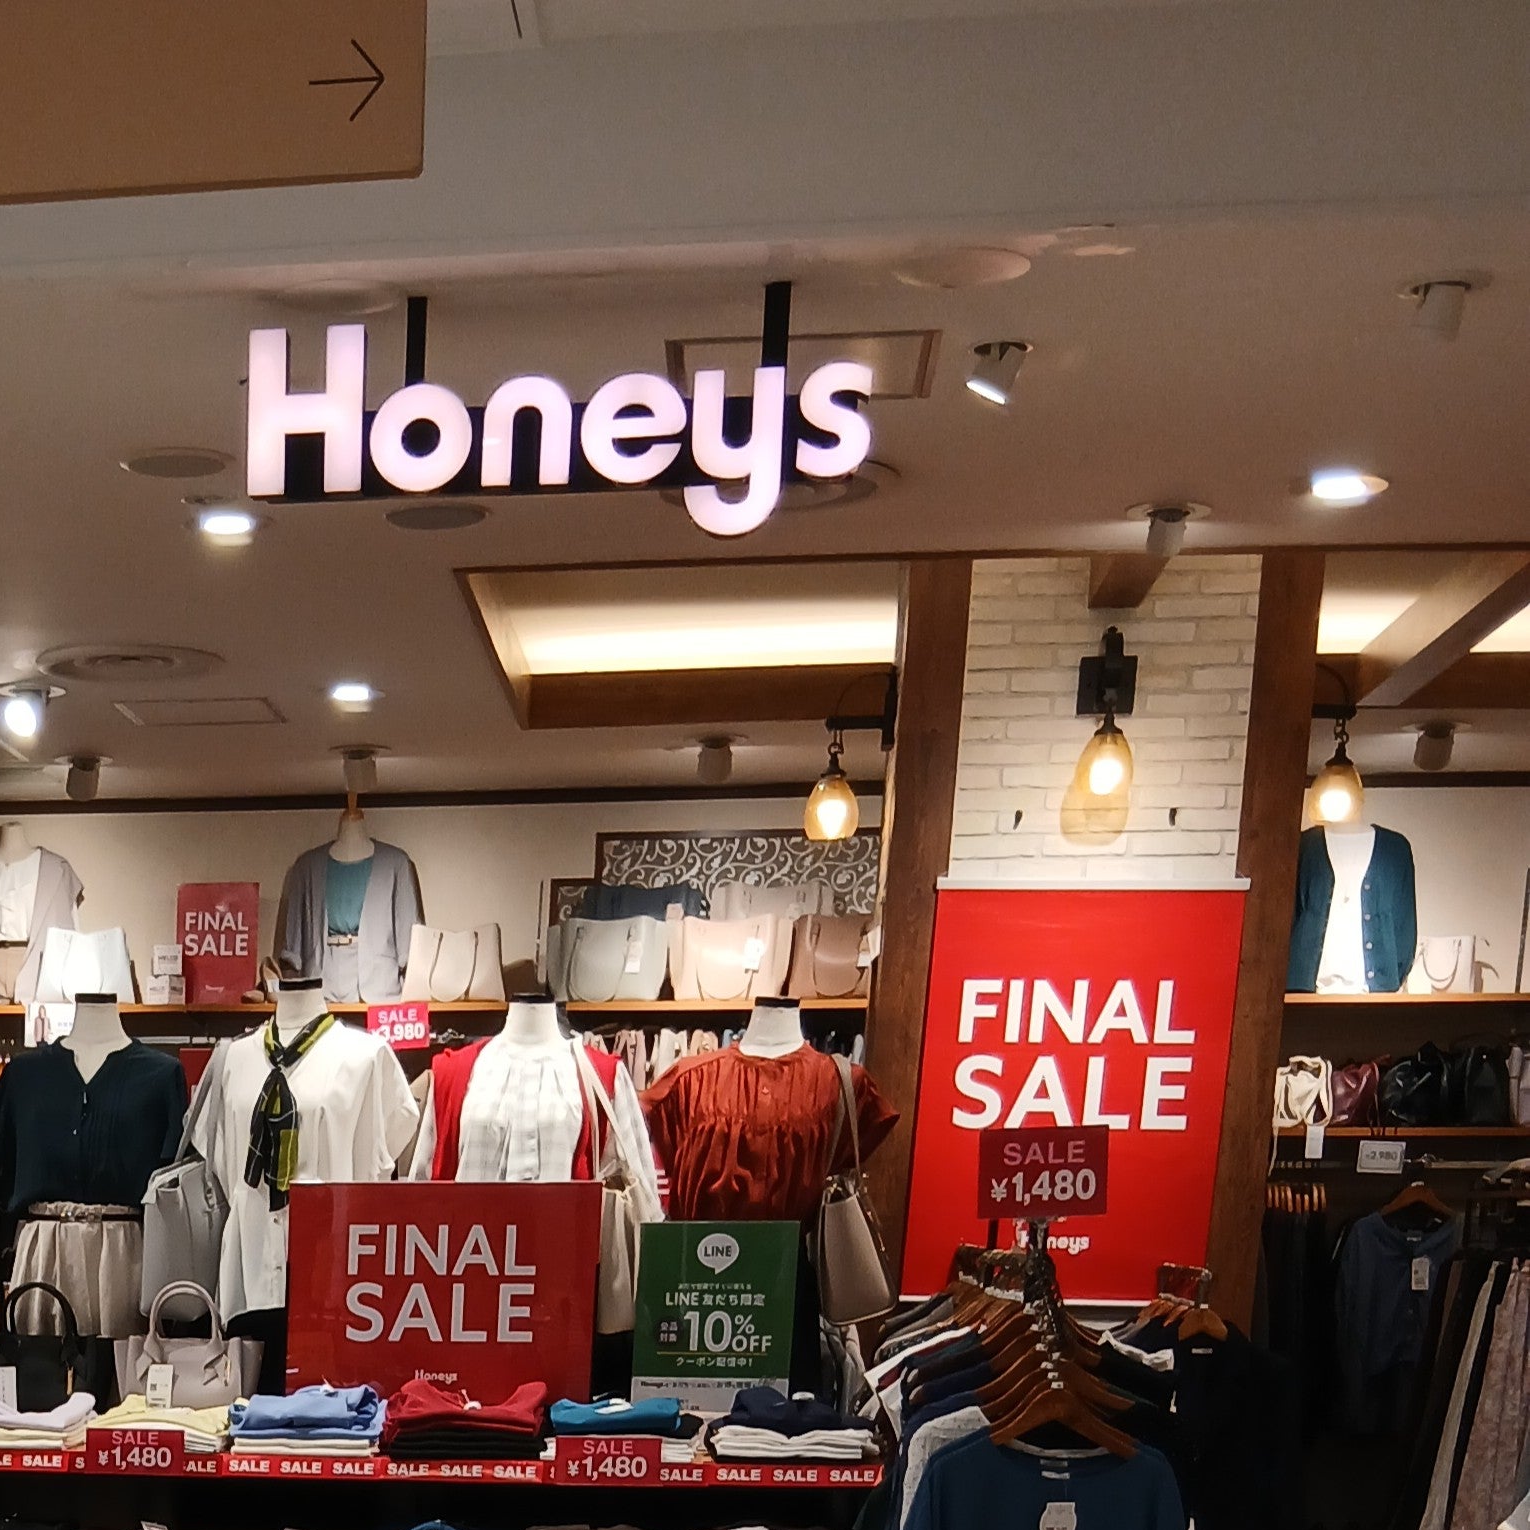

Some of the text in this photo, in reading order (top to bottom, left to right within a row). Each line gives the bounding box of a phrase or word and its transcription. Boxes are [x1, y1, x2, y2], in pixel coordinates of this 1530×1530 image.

[246, 323, 874, 537] Honeys
[185, 911, 249, 931] FINAL
[184, 933, 249, 956] SALE
[378, 1008, 418, 1024] SALE
[957, 979, 1196, 1044] FINAL
[952, 1054, 1193, 1131] SALE
[1003, 1140, 1086, 1166] SALE
[991, 1169, 1097, 1206] ¥1,480
[347, 1224, 537, 1276] FINAL
[703, 1246, 732, 1257] LINE
[665, 1292, 700, 1306] LINE
[345, 1281, 535, 1343] SALE
[731, 1335, 772, 1353] OFF
[415, 1369, 458, 1385] Honeys
[111, 1431, 159, 1445] SALE
[582, 1440, 634, 1455] SALE
[22, 1454, 62, 1468] SALE
[98, 1446, 172, 1471] ¥1,480
[567, 1455, 648, 1481] ¥1,480
[184, 1460, 216, 1472] ALE
[228, 1459, 270, 1473] SALE
[279, 1461, 322, 1474] SALE
[332, 1462, 375, 1475] SALE
[387, 1463, 429, 1476] SALE
[440, 1464, 483, 1477] SALE
[493, 1465, 536, 1479] SALE
[660, 1468, 875, 1482] SALE SALE SALE SALE
